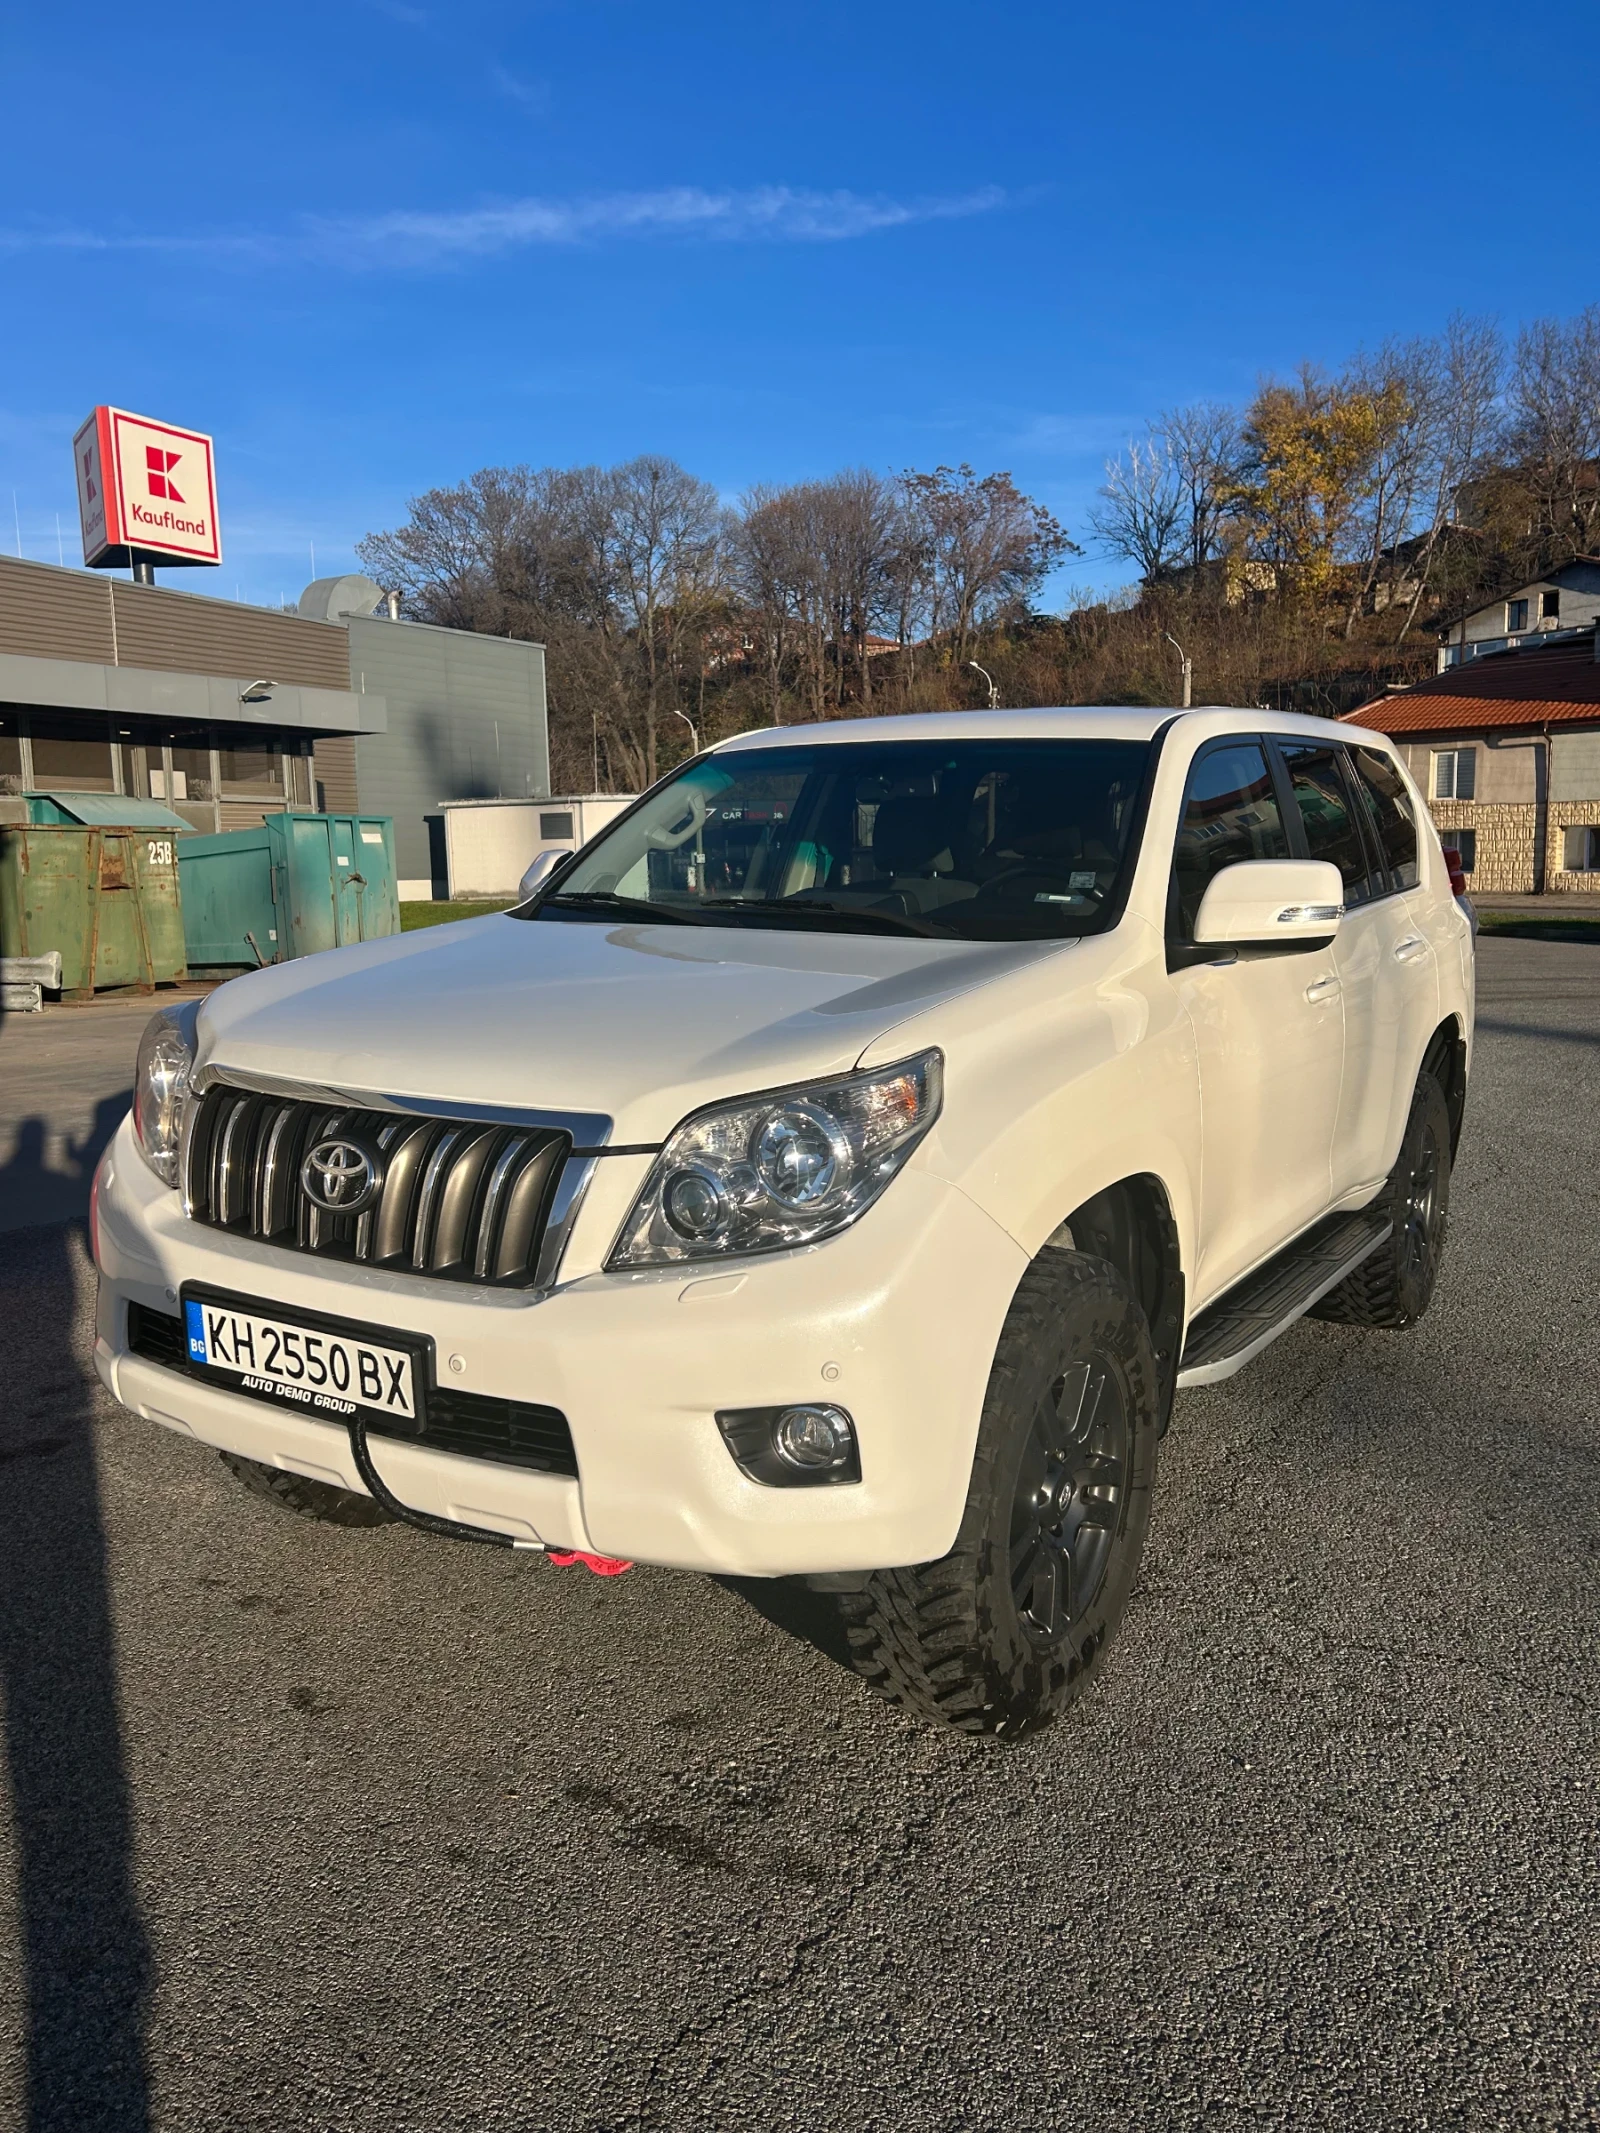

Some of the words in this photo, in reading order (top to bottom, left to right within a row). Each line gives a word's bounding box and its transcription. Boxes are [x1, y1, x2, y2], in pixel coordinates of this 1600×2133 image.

[132, 503, 206, 536] Kaufland
[722, 811, 742, 820] CAR
[148, 841, 172, 865] 25B
[190, 1338, 205, 1354] BG
[208, 1312, 256, 1369] KH
[261, 1326, 350, 1392] 2550
[357, 1348, 410, 1410] BX
[241, 1375, 274, 1393] AUTO
[275, 1384, 311, 1403] DEMO
[314, 1393, 357, 1415] GROUP
